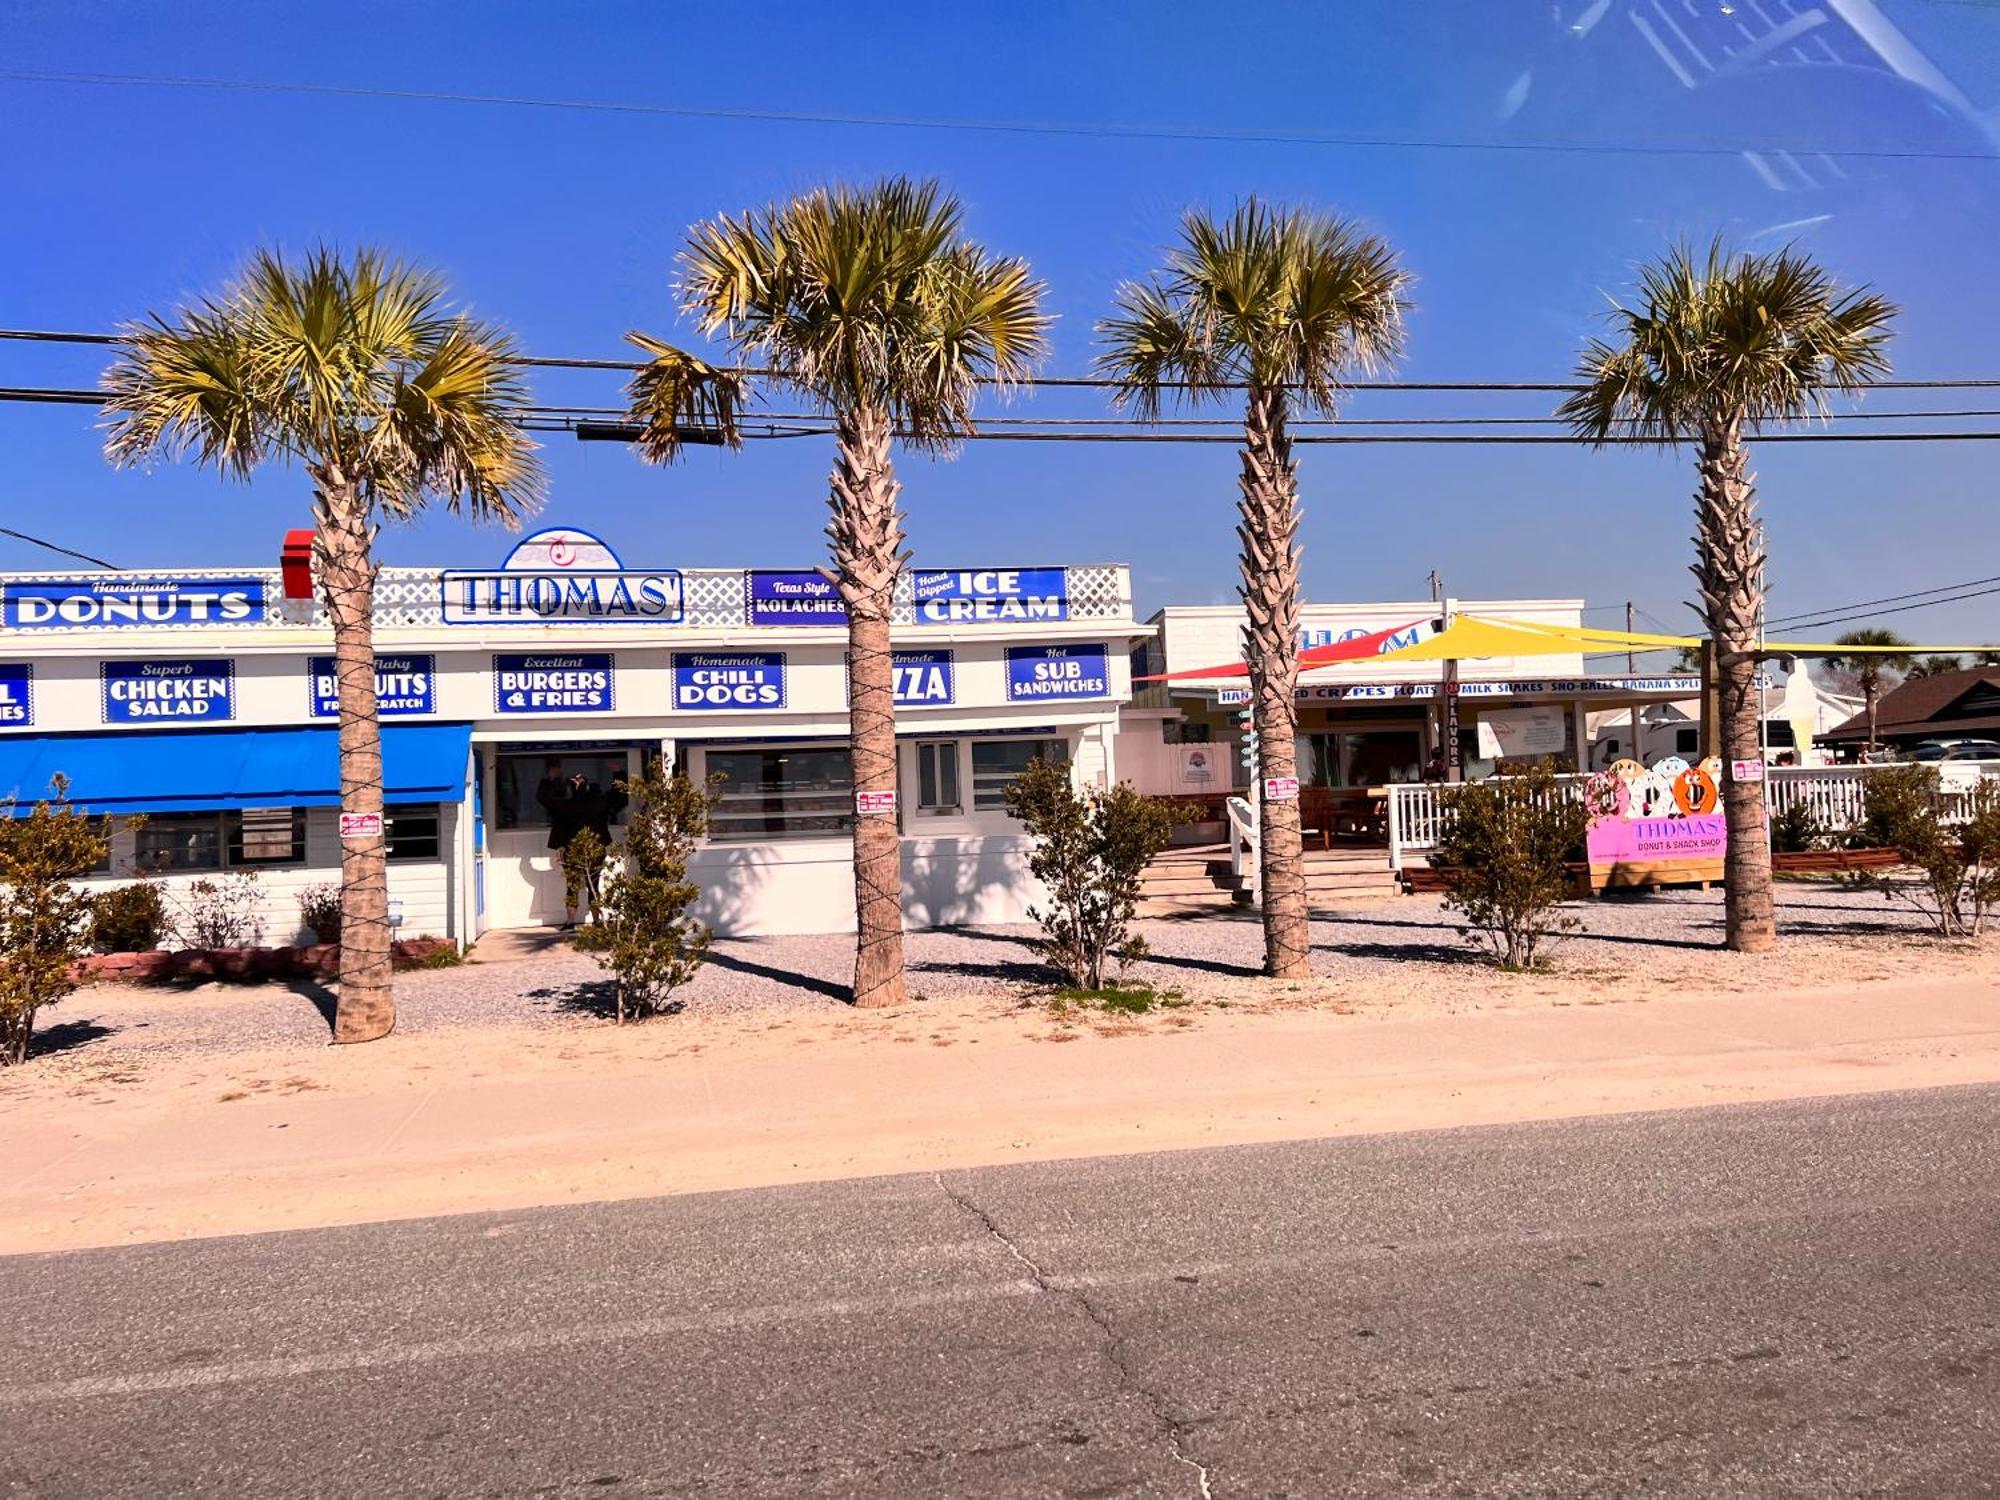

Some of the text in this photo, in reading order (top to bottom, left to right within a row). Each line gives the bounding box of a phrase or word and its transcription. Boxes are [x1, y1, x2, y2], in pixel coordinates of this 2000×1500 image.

[917, 571, 949, 586] Hand
[960, 571, 1021, 595] ICE
[91, 581, 180, 593] Handmade
[773, 582, 830, 596] Texas Style
[917, 580, 955, 597] Dipped
[453, 576, 675, 616] THOMAS'
[18, 592, 250, 623] DONUTS
[757, 599, 845, 613] KOLACHES
[924, 595, 1060, 620] CREAM
[691, 655, 767, 668] Homemade
[1046, 648, 1067, 659] Hot
[142, 664, 193, 678] Superb
[524, 657, 583, 669] Excellent
[1034, 661, 1081, 680] SUB
[317, 673, 428, 698] BIUITS
[502, 672, 607, 690] BURGERS
[692, 670, 764, 685] CHILI
[892, 666, 948, 701] ZZA
[110, 679, 226, 700] CHICKEN
[679, 684, 780, 704] DOGS
[1014, 678, 1104, 696] SANDWICHES
[1316, 687, 1386, 698] CREPES
[1394, 685, 1437, 696] FLOATS
[1461, 684, 1492, 694] MILK
[1497, 682, 1543, 693] SHAKES
[1551, 681, 1616, 692] SNO-BALLS
[1621, 680, 1672, 689] BANANA
[1674, 679, 1699, 689] SPLI
[506, 691, 602, 707] & FRIES
[1221, 691, 1249, 701] HAN
[128, 700, 209, 717] SALAD
[1449, 697, 1459, 766] FLAVORS
[1633, 818, 1722, 839] THOMAS'
[1638, 841, 1664, 852] DONUT
[1701, 838, 1721, 847] SHOP
